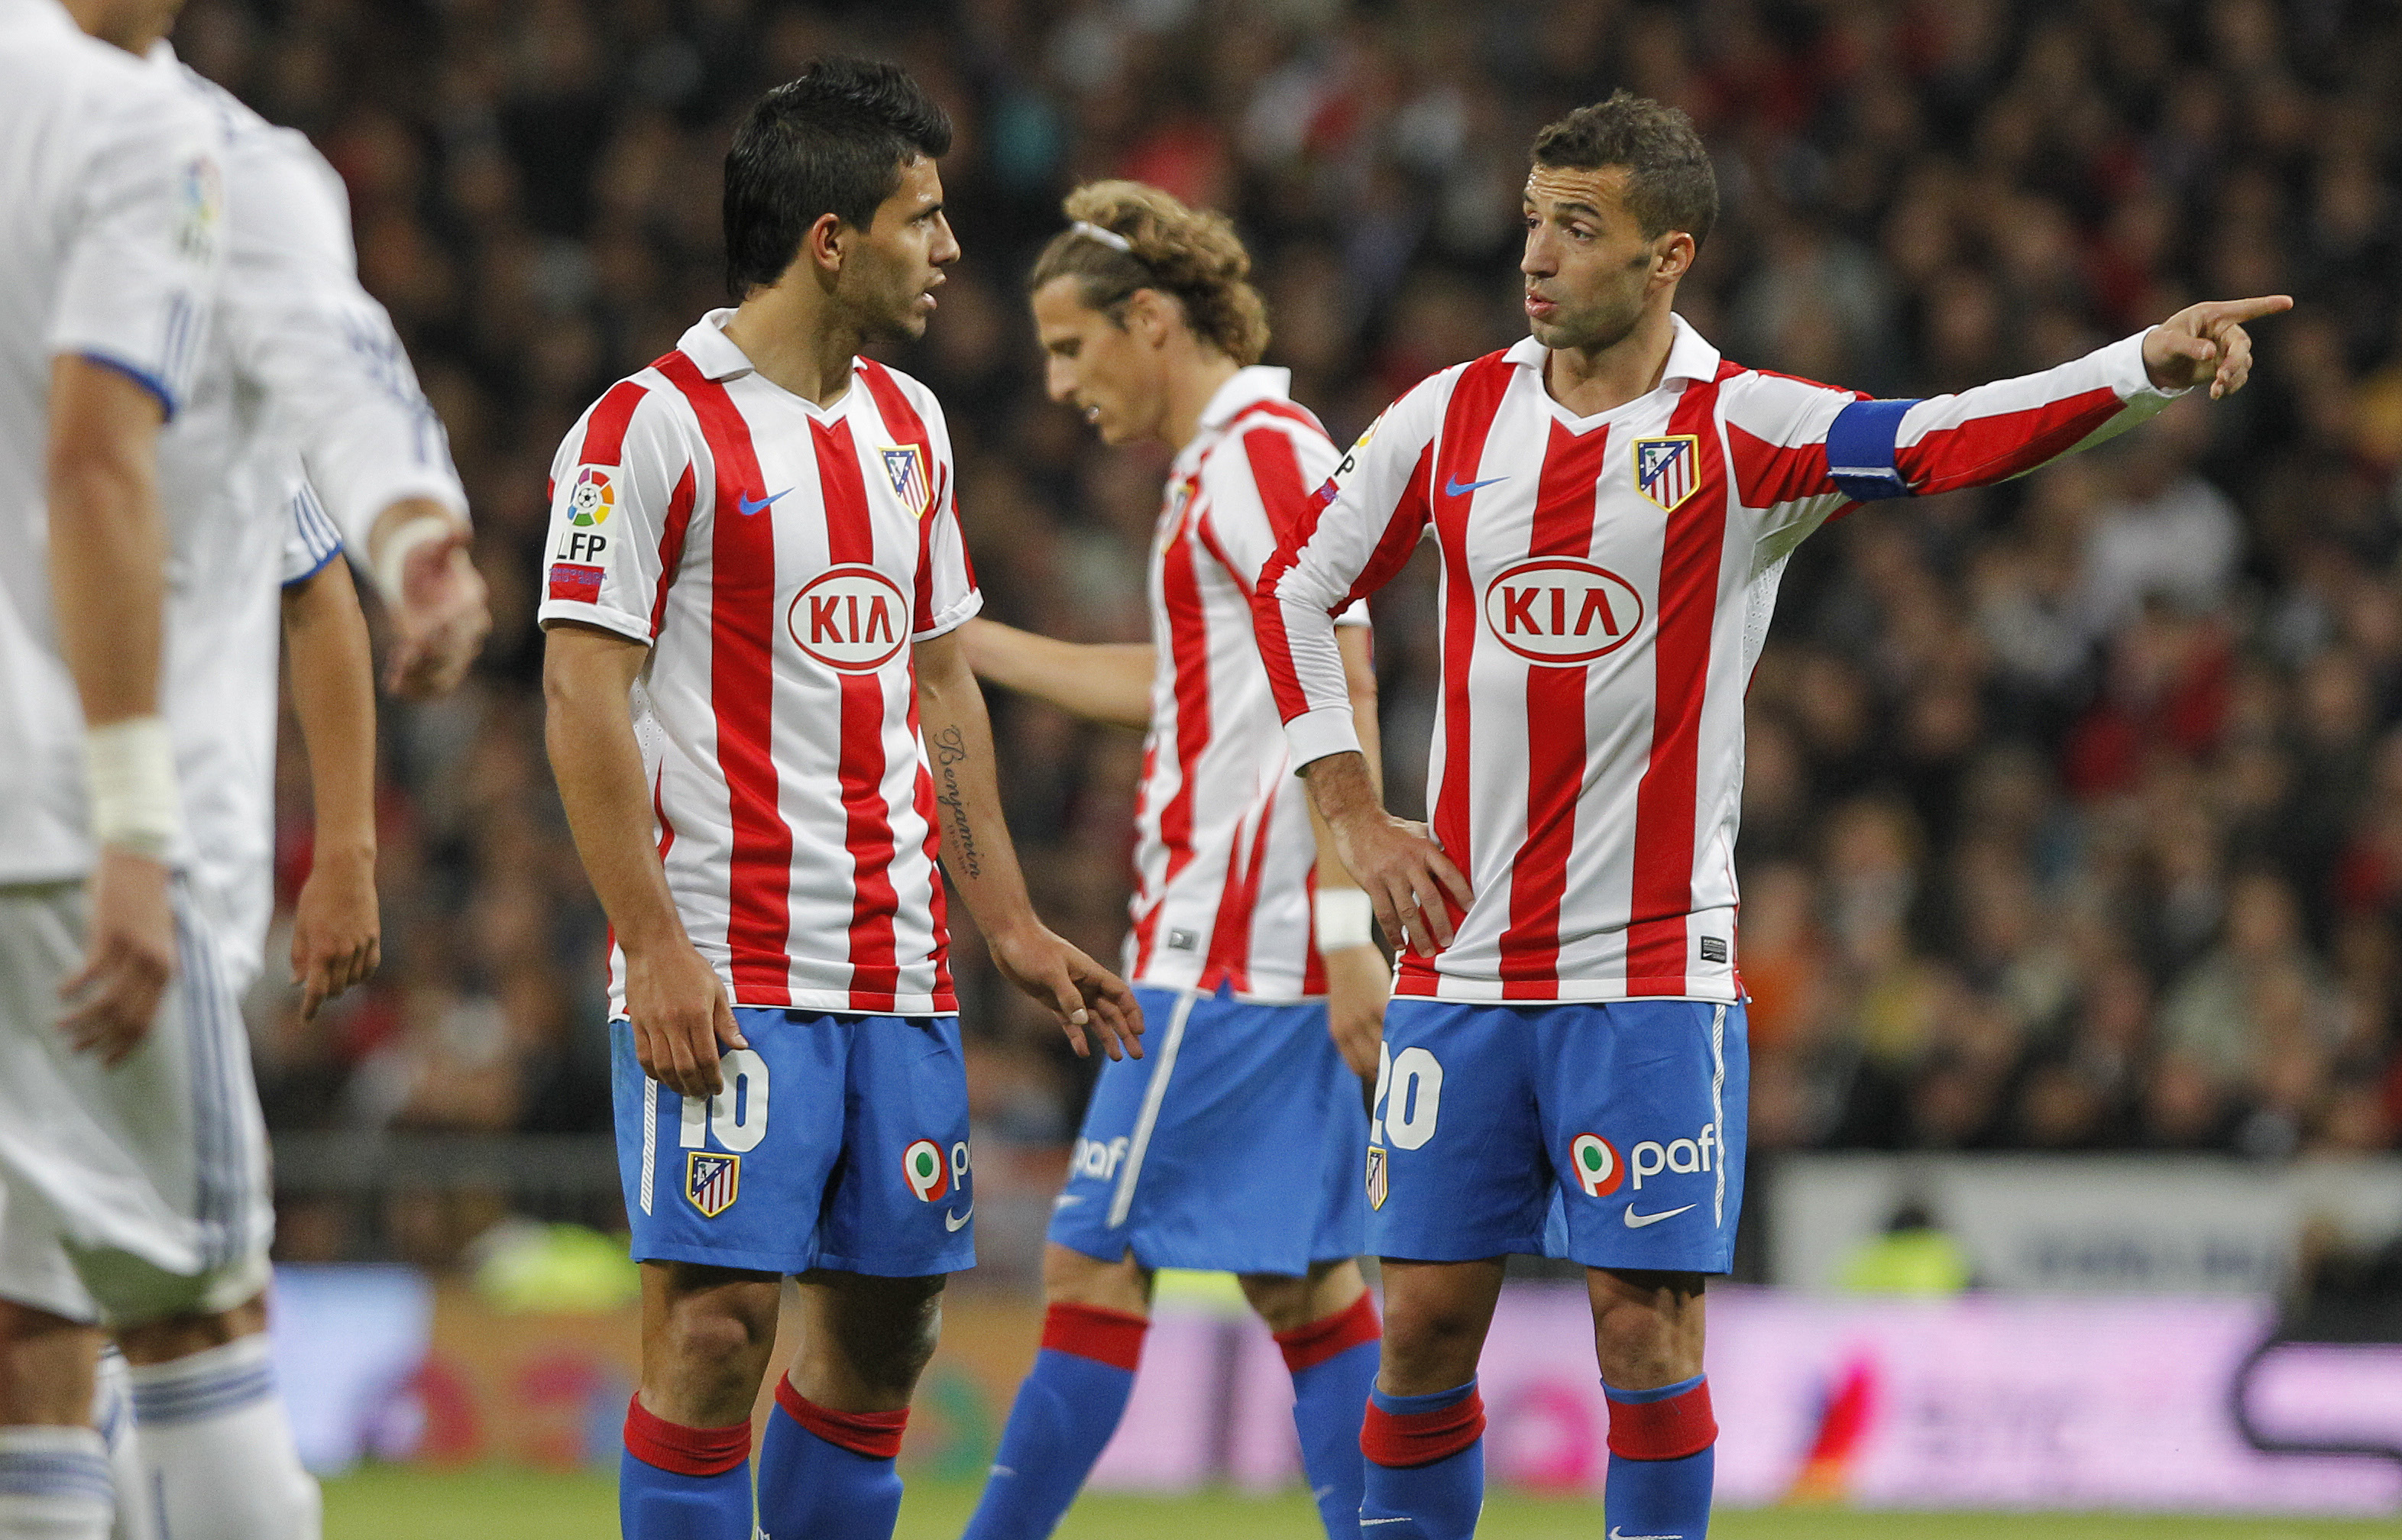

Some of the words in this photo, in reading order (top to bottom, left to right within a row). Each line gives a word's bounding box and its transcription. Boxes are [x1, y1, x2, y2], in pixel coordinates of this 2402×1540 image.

[556, 532, 607, 561] LFP
[808, 595, 893, 643] KIA
[1501, 586, 1619, 636] KIA
[934, 724, 986, 879] Benjamin
[951, 1140, 972, 1190] p
[1630, 1123, 1715, 1189] paf
